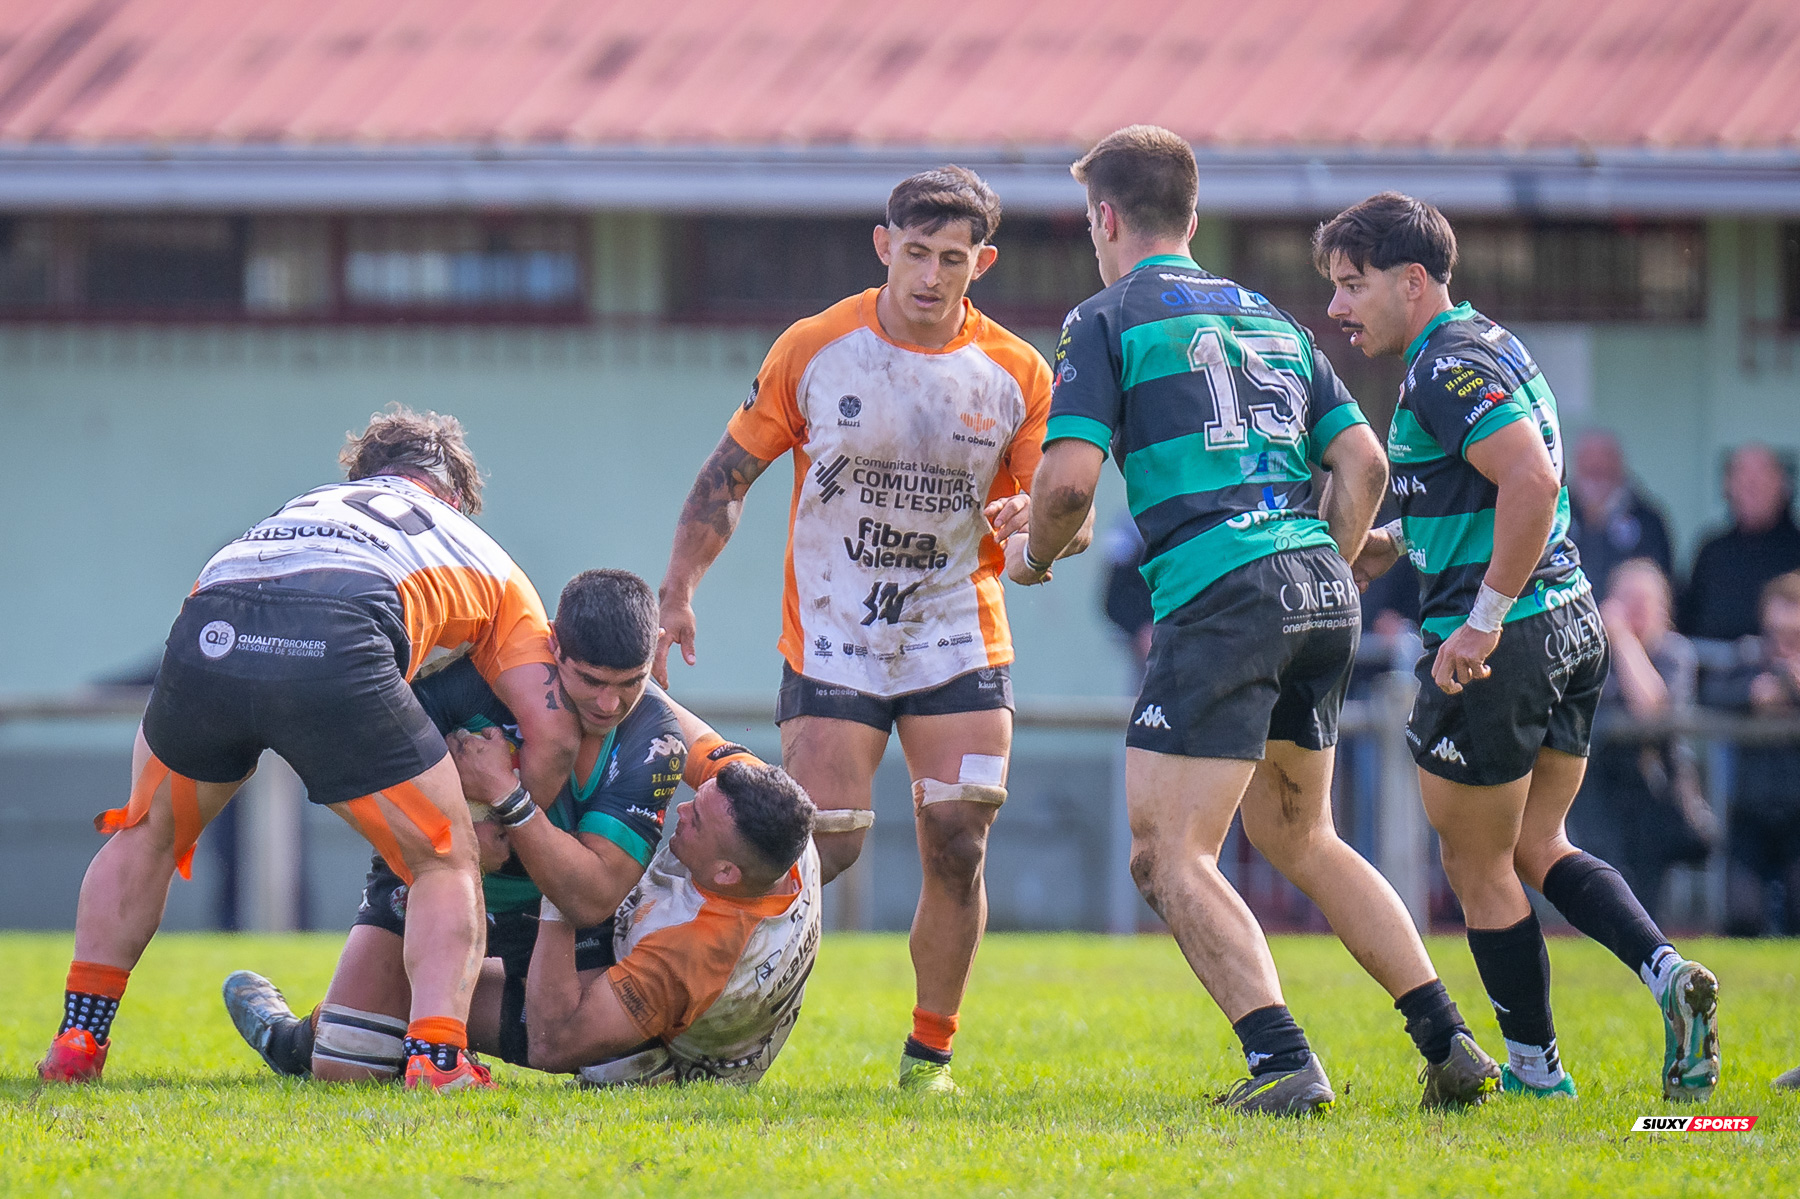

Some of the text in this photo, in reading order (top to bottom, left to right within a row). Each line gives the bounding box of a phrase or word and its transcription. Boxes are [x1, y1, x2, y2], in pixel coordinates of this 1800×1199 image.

[1187, 327, 1308, 450] 15
[1457, 377, 1484, 398] GUYO
[854, 455, 918, 472] Comunitat
[860, 487, 887, 508] DE
[843, 536, 948, 570] Valencia
[1280, 578, 1358, 612] ONERA
[205, 630, 229, 646] QB
[238, 634, 327, 650] QUALITYBROKERS
[235, 642, 325, 658] ASESORES DE SEGUROS
